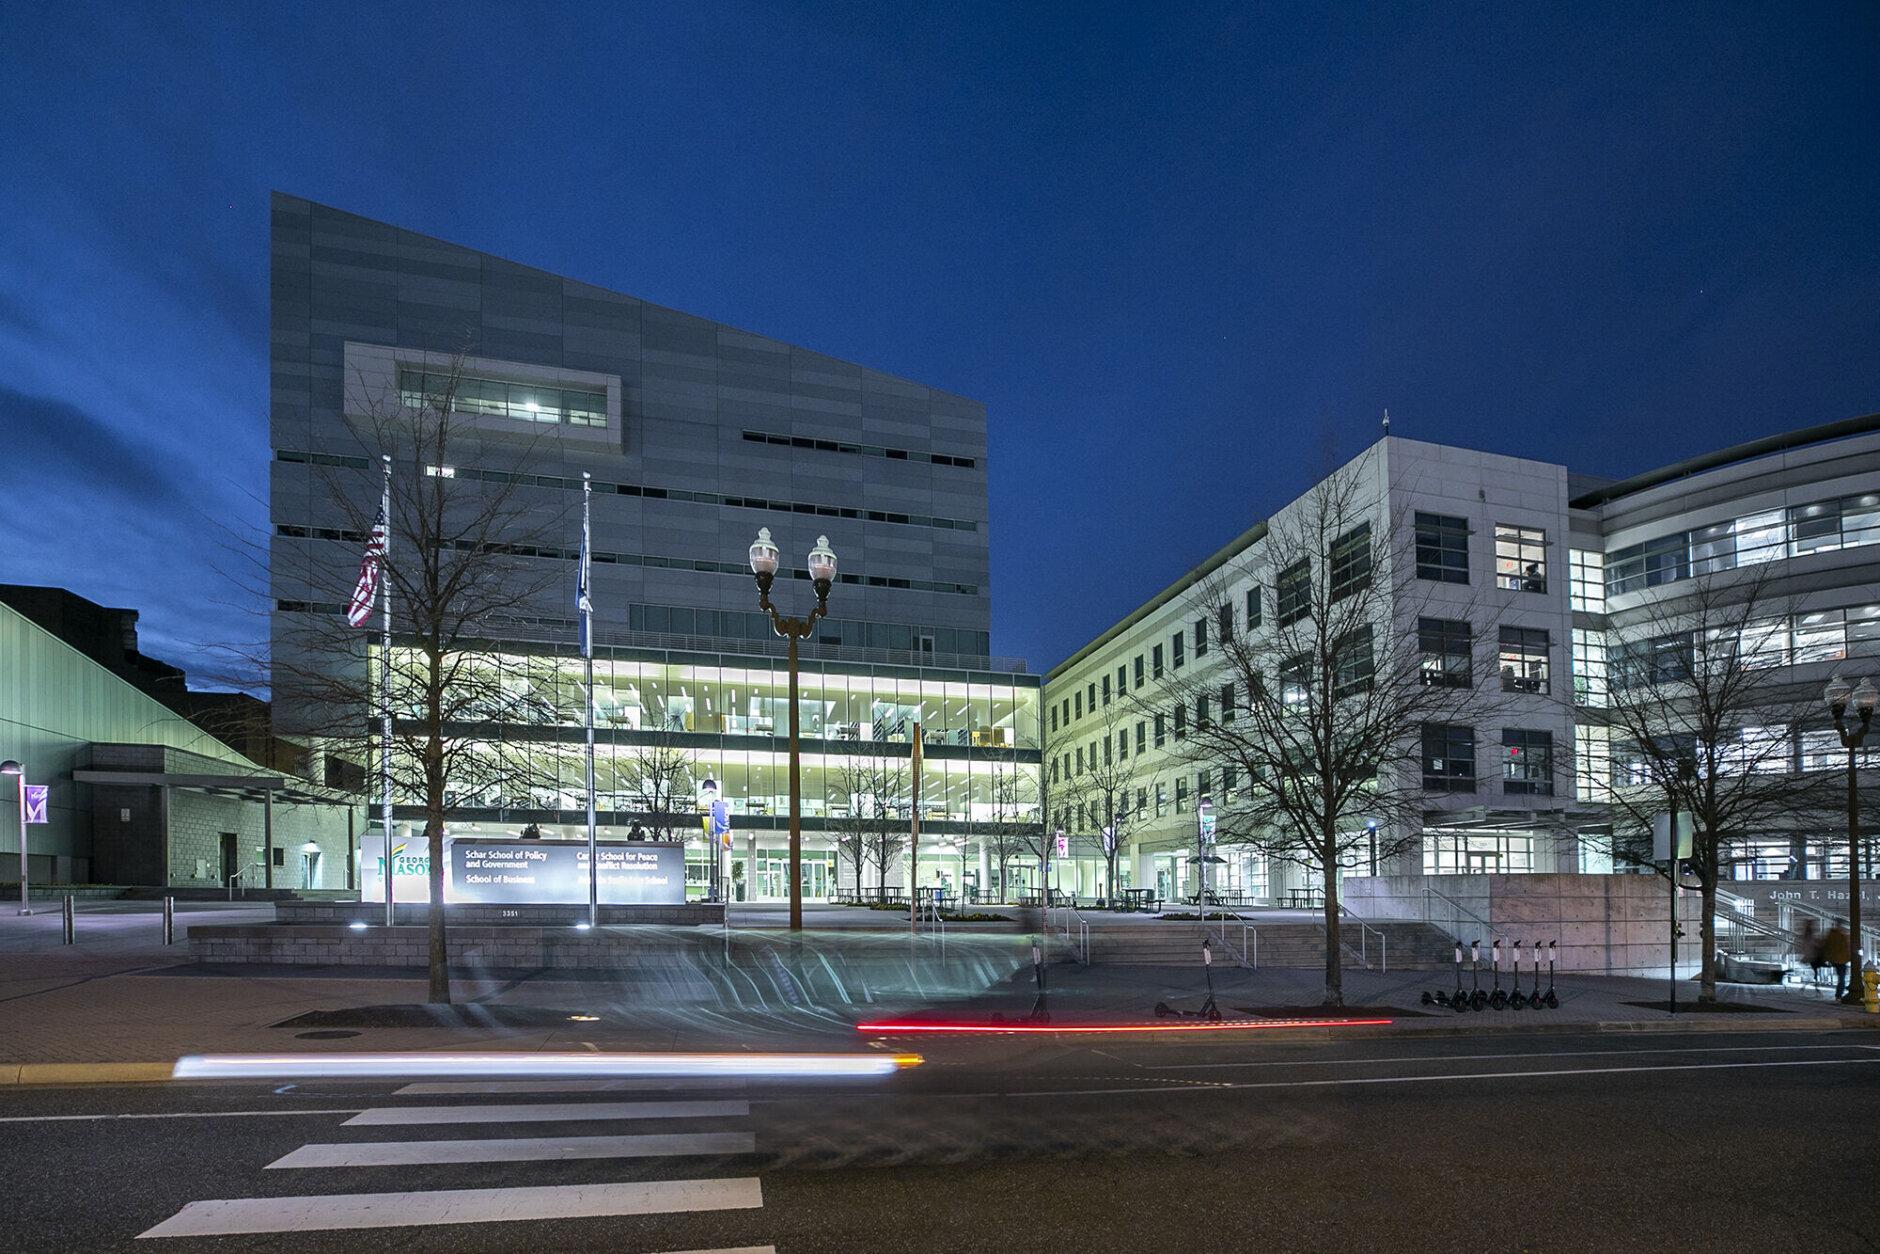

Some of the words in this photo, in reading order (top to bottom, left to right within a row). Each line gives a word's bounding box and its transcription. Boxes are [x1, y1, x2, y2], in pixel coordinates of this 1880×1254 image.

[466, 850, 486, 859] Schar
[488, 850, 513, 859] School
[515, 851, 524, 859] of
[525, 852, 548, 862] Policy
[601, 852, 624, 861] School
[626, 852, 636, 861] for
[638, 852, 658, 862] Peace
[466, 860, 480, 868] and
[482, 860, 528, 869] Government
[466, 874, 492, 884] School
[494, 874, 503, 884] of
[1770, 890, 1802, 900] John
[1809, 890, 1820, 900] T.
[1827, 890, 1870, 900] Hazl,
